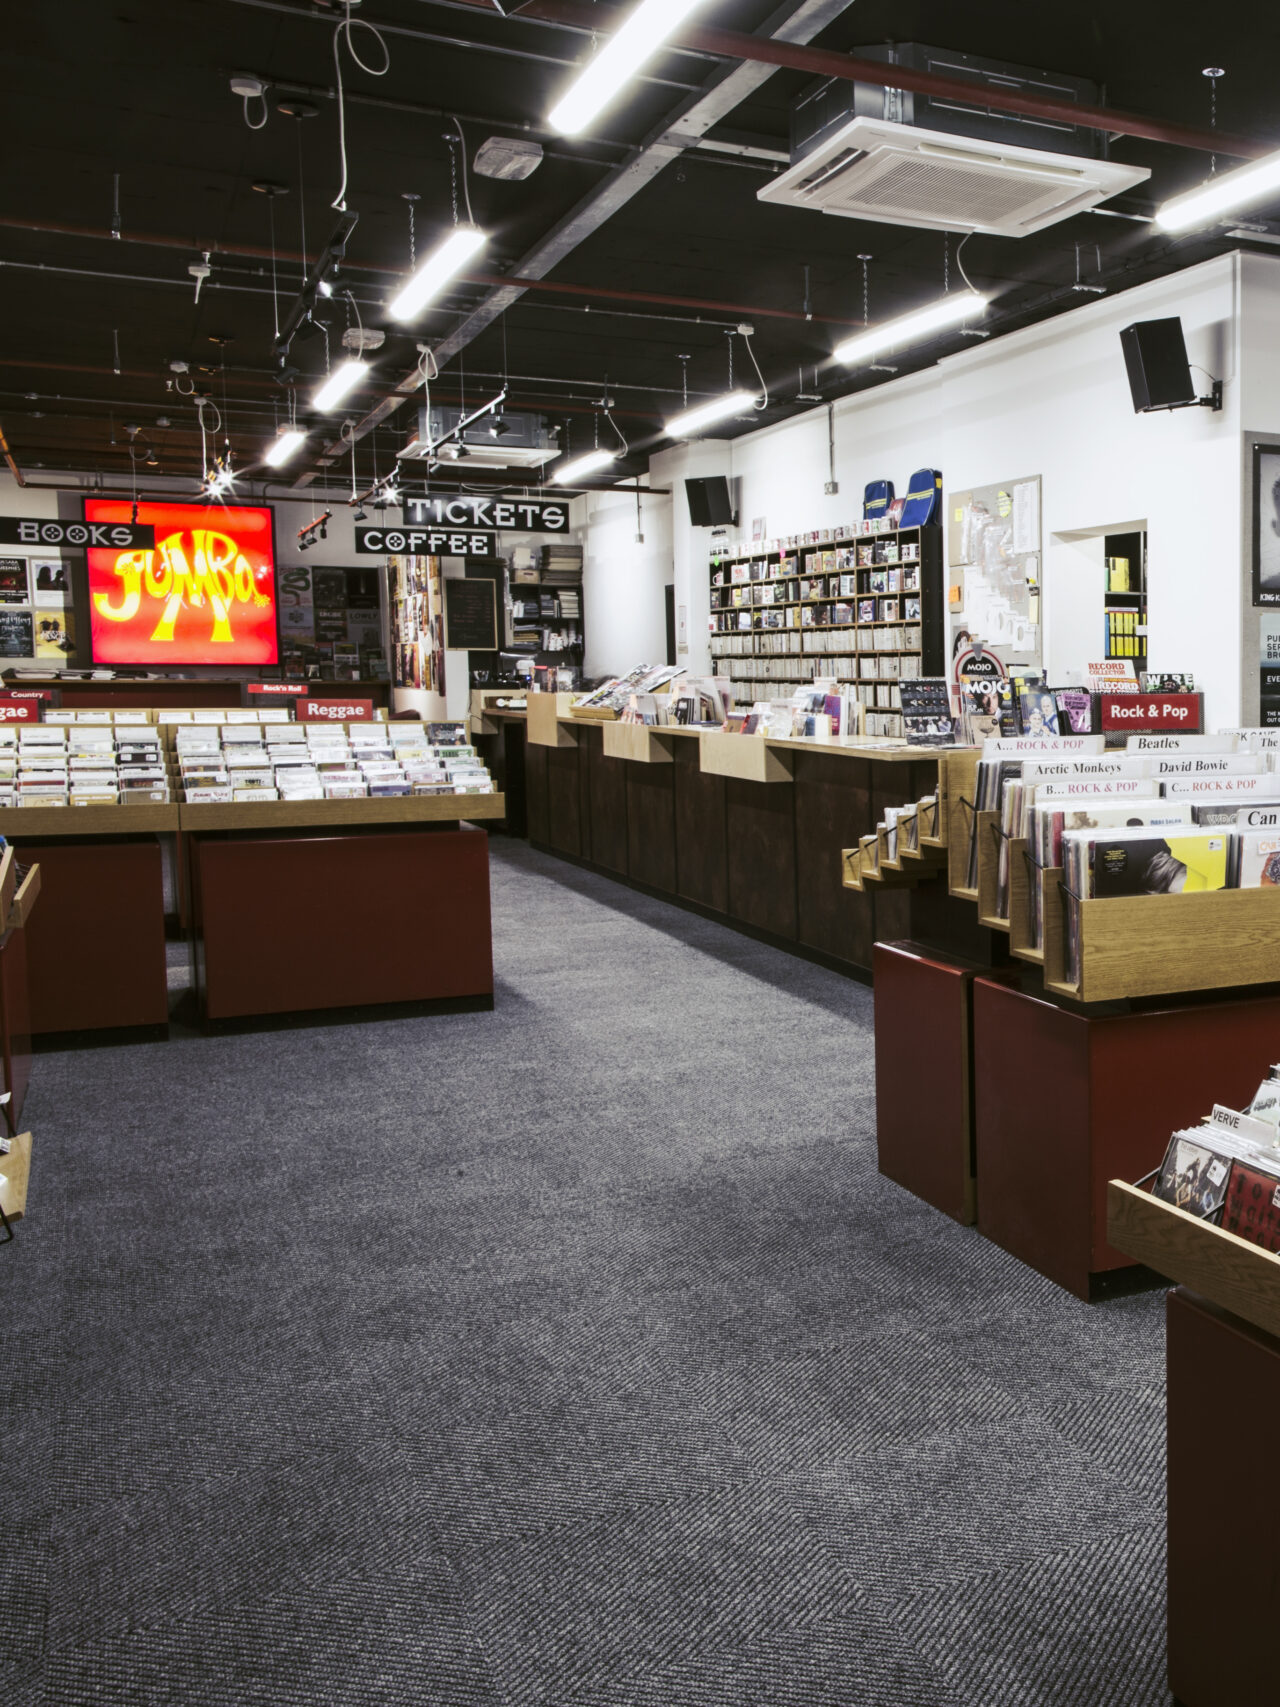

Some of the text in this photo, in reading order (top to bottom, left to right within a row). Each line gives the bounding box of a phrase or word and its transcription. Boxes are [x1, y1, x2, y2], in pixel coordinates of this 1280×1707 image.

[407, 497, 565, 529] TICKETS
[18, 522, 134, 546] BOOKS
[364, 531, 488, 555] COFFEE
[1260, 594, 1274, 602] KING
[966, 680, 1010, 694] MOJO
[1099, 682, 1138, 690] RECORD
[11, 691, 43, 699] Country
[308, 703, 364, 719] Reggae
[1111, 705, 1188, 720] Rock & Pop
[1017, 741, 1048, 750] ROCK
[1051, 741, 1060, 749] &
[1063, 740, 1084, 748] POP
[1138, 738, 1179, 749] Beatles
[1261, 737, 1280, 747] The
[1035, 762, 1121, 776] Arctic Monkeys
[1159, 759, 1228, 773] David Bowie
[1046, 782, 1138, 795] B... ROCK & POP
[1248, 811, 1277, 825] Can
[1213, 1110, 1240, 1129] VERVE
